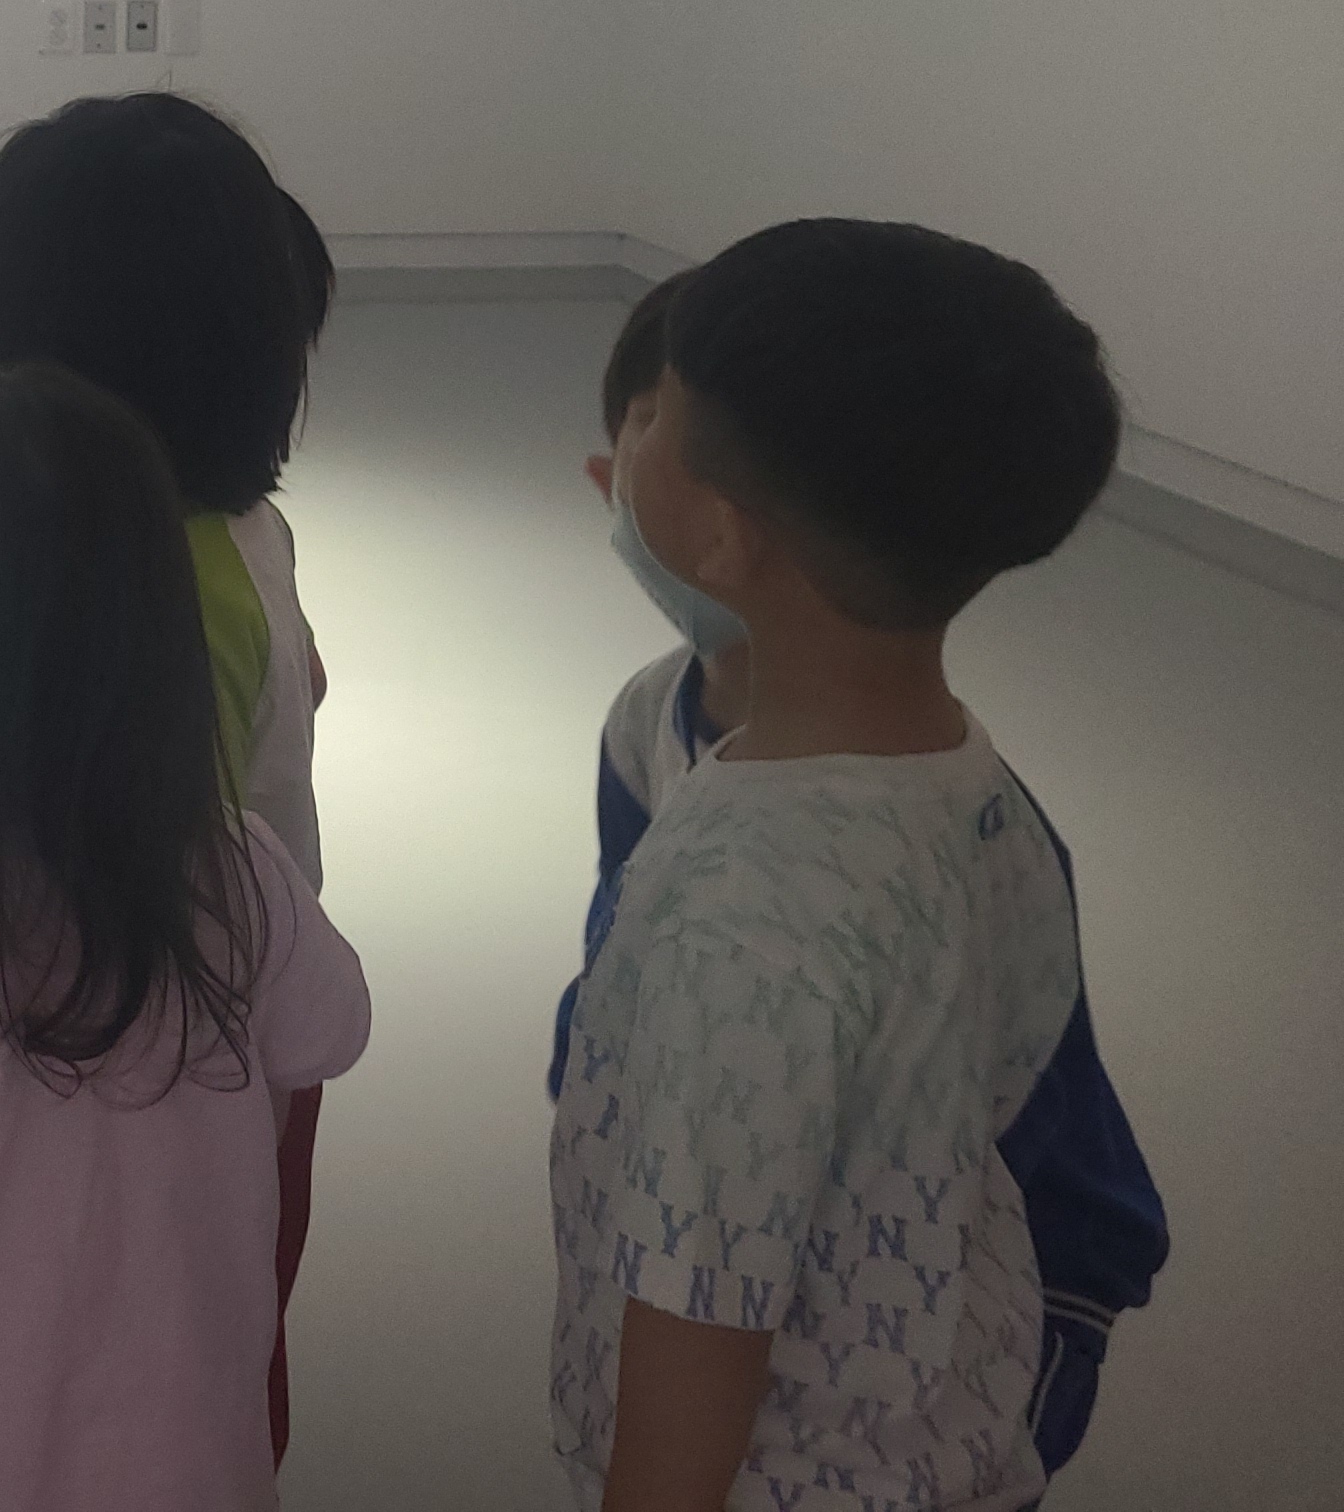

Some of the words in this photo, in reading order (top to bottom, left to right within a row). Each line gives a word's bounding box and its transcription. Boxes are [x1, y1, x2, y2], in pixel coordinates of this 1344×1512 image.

[914, 1175, 952, 1223] Y
[659, 1201, 699, 1258] Y
[718, 1218, 749, 1271] Y
[866, 1214, 908, 1261] N
[611, 1231, 648, 1295] N
[686, 1265, 716, 1320] N
[741, 1274, 775, 1329] N
[914, 1265, 951, 1315] Y
[863, 1303, 909, 1355] N
[820, 1343, 856, 1389] Y
